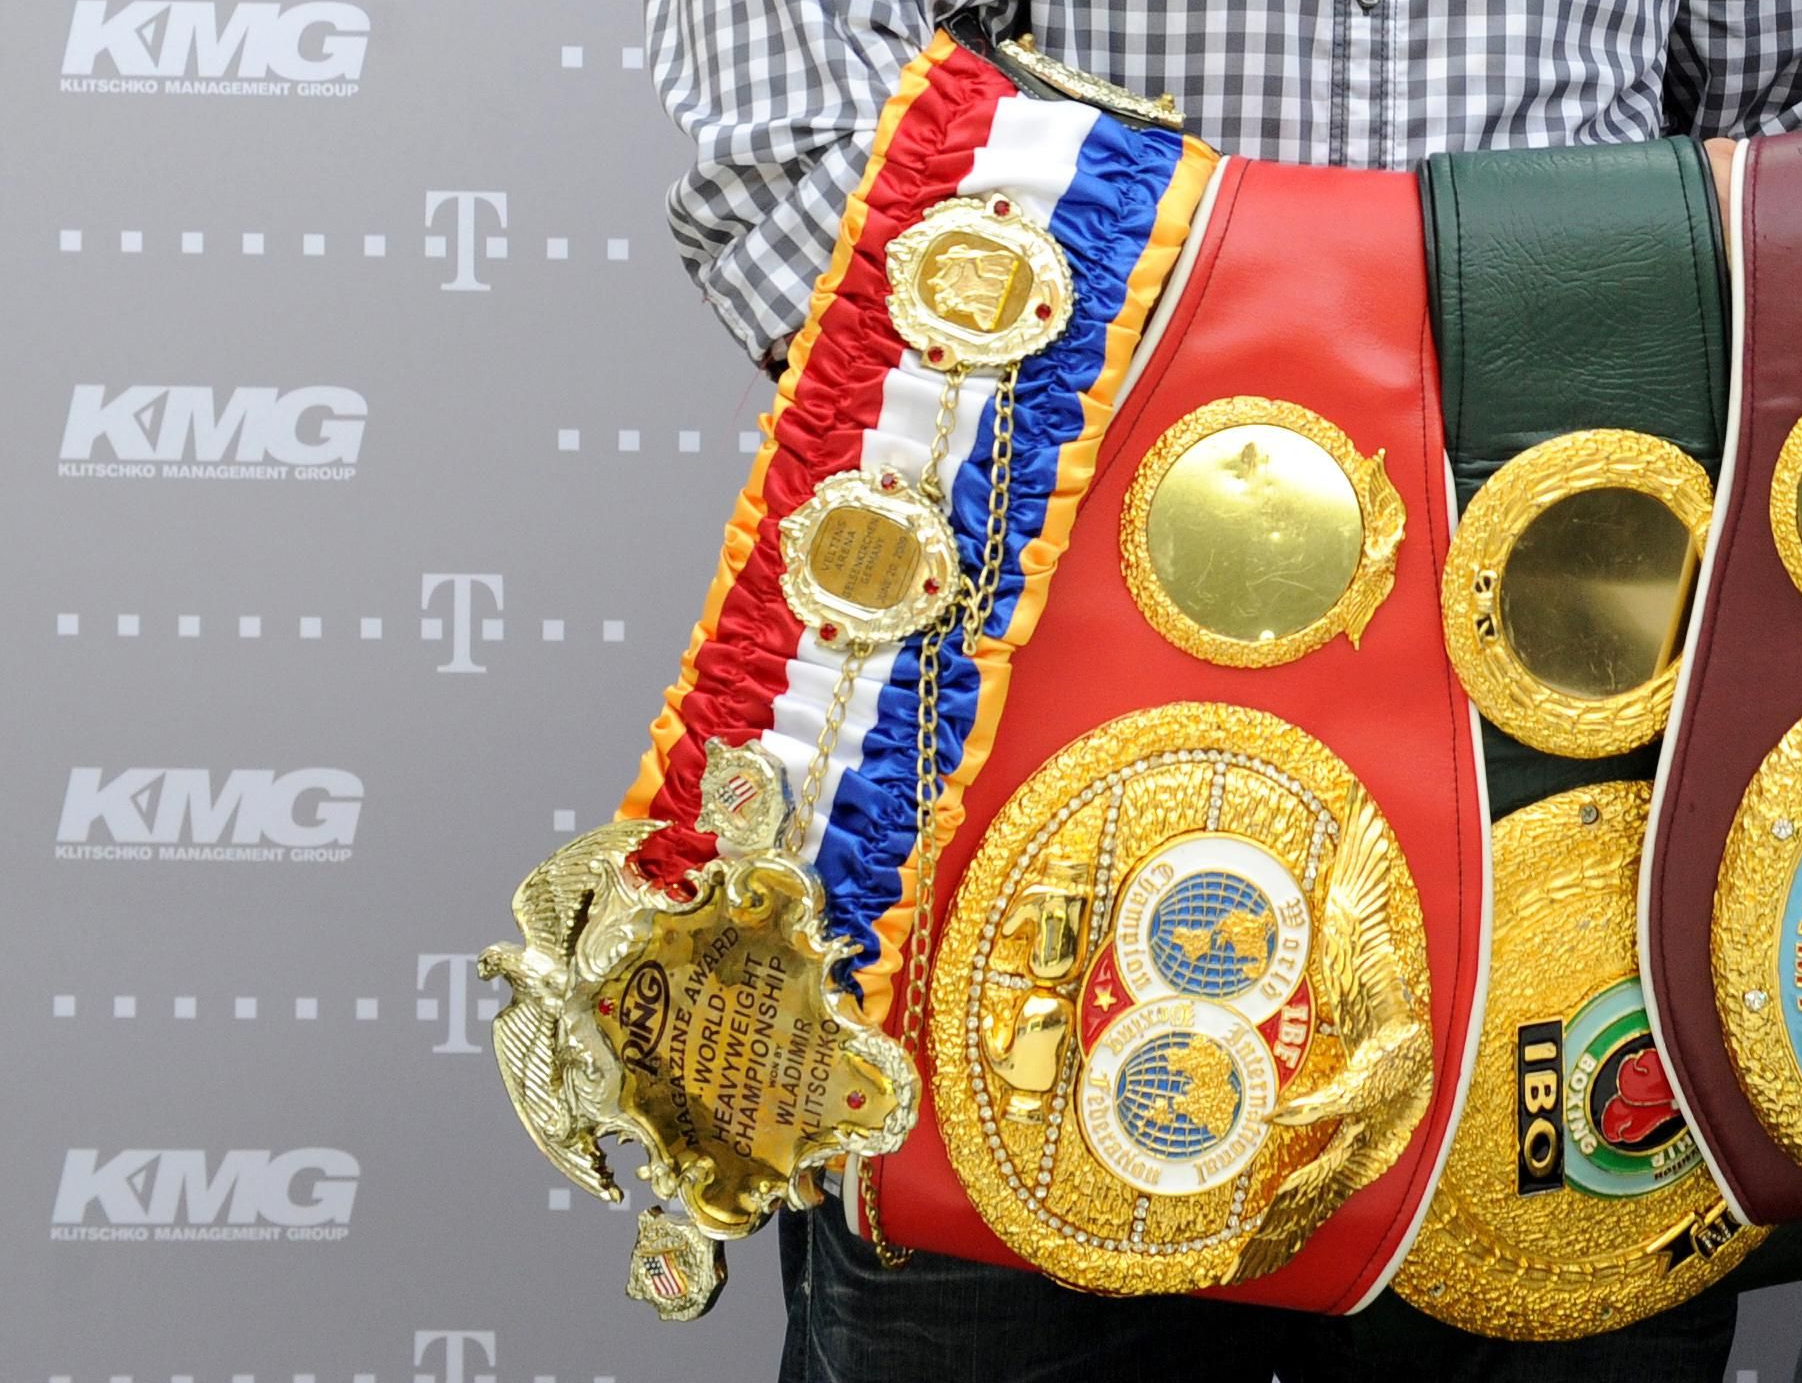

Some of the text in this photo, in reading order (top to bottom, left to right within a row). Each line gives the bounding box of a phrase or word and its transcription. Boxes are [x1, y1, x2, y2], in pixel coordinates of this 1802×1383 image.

[62, 0, 370, 81] KMG
[60, 78, 359, 97] KLITSCHKO MANAGEMENT GROUP
[426, 192, 507, 290] T
[60, 385, 368, 465] KMG
[58, 463, 356, 480] KLITSCHKO MANAGEMENT GROUP
[835, 530, 856, 572] ARENA
[422, 574, 503, 672] T
[57, 767, 364, 846] KMG
[55, 845, 352, 862] KLITSCHKO MANAGEMENT GROUP
[620, 967, 665, 1076] RING
[669, 925, 740, 1148] MAGAZINE AWARD
[711, 952, 764, 1146] HEAVYWEIGHT
[733, 955, 787, 1159] CHAMPIONSHIP
[1272, 1004, 1310, 1070] IBF
[768, 1044, 786, 1090] WON BY
[774, 1017, 813, 1128] WLADIMIR
[800, 1018, 842, 1144] KLITSCHKO
[1566, 1051, 1599, 1156] BOXING
[1523, 1040, 1558, 1178] IBO
[52, 1148, 360, 1226] KMG
[50, 1226, 349, 1241] KLITSCHKO MANAGEMENT GROUP
